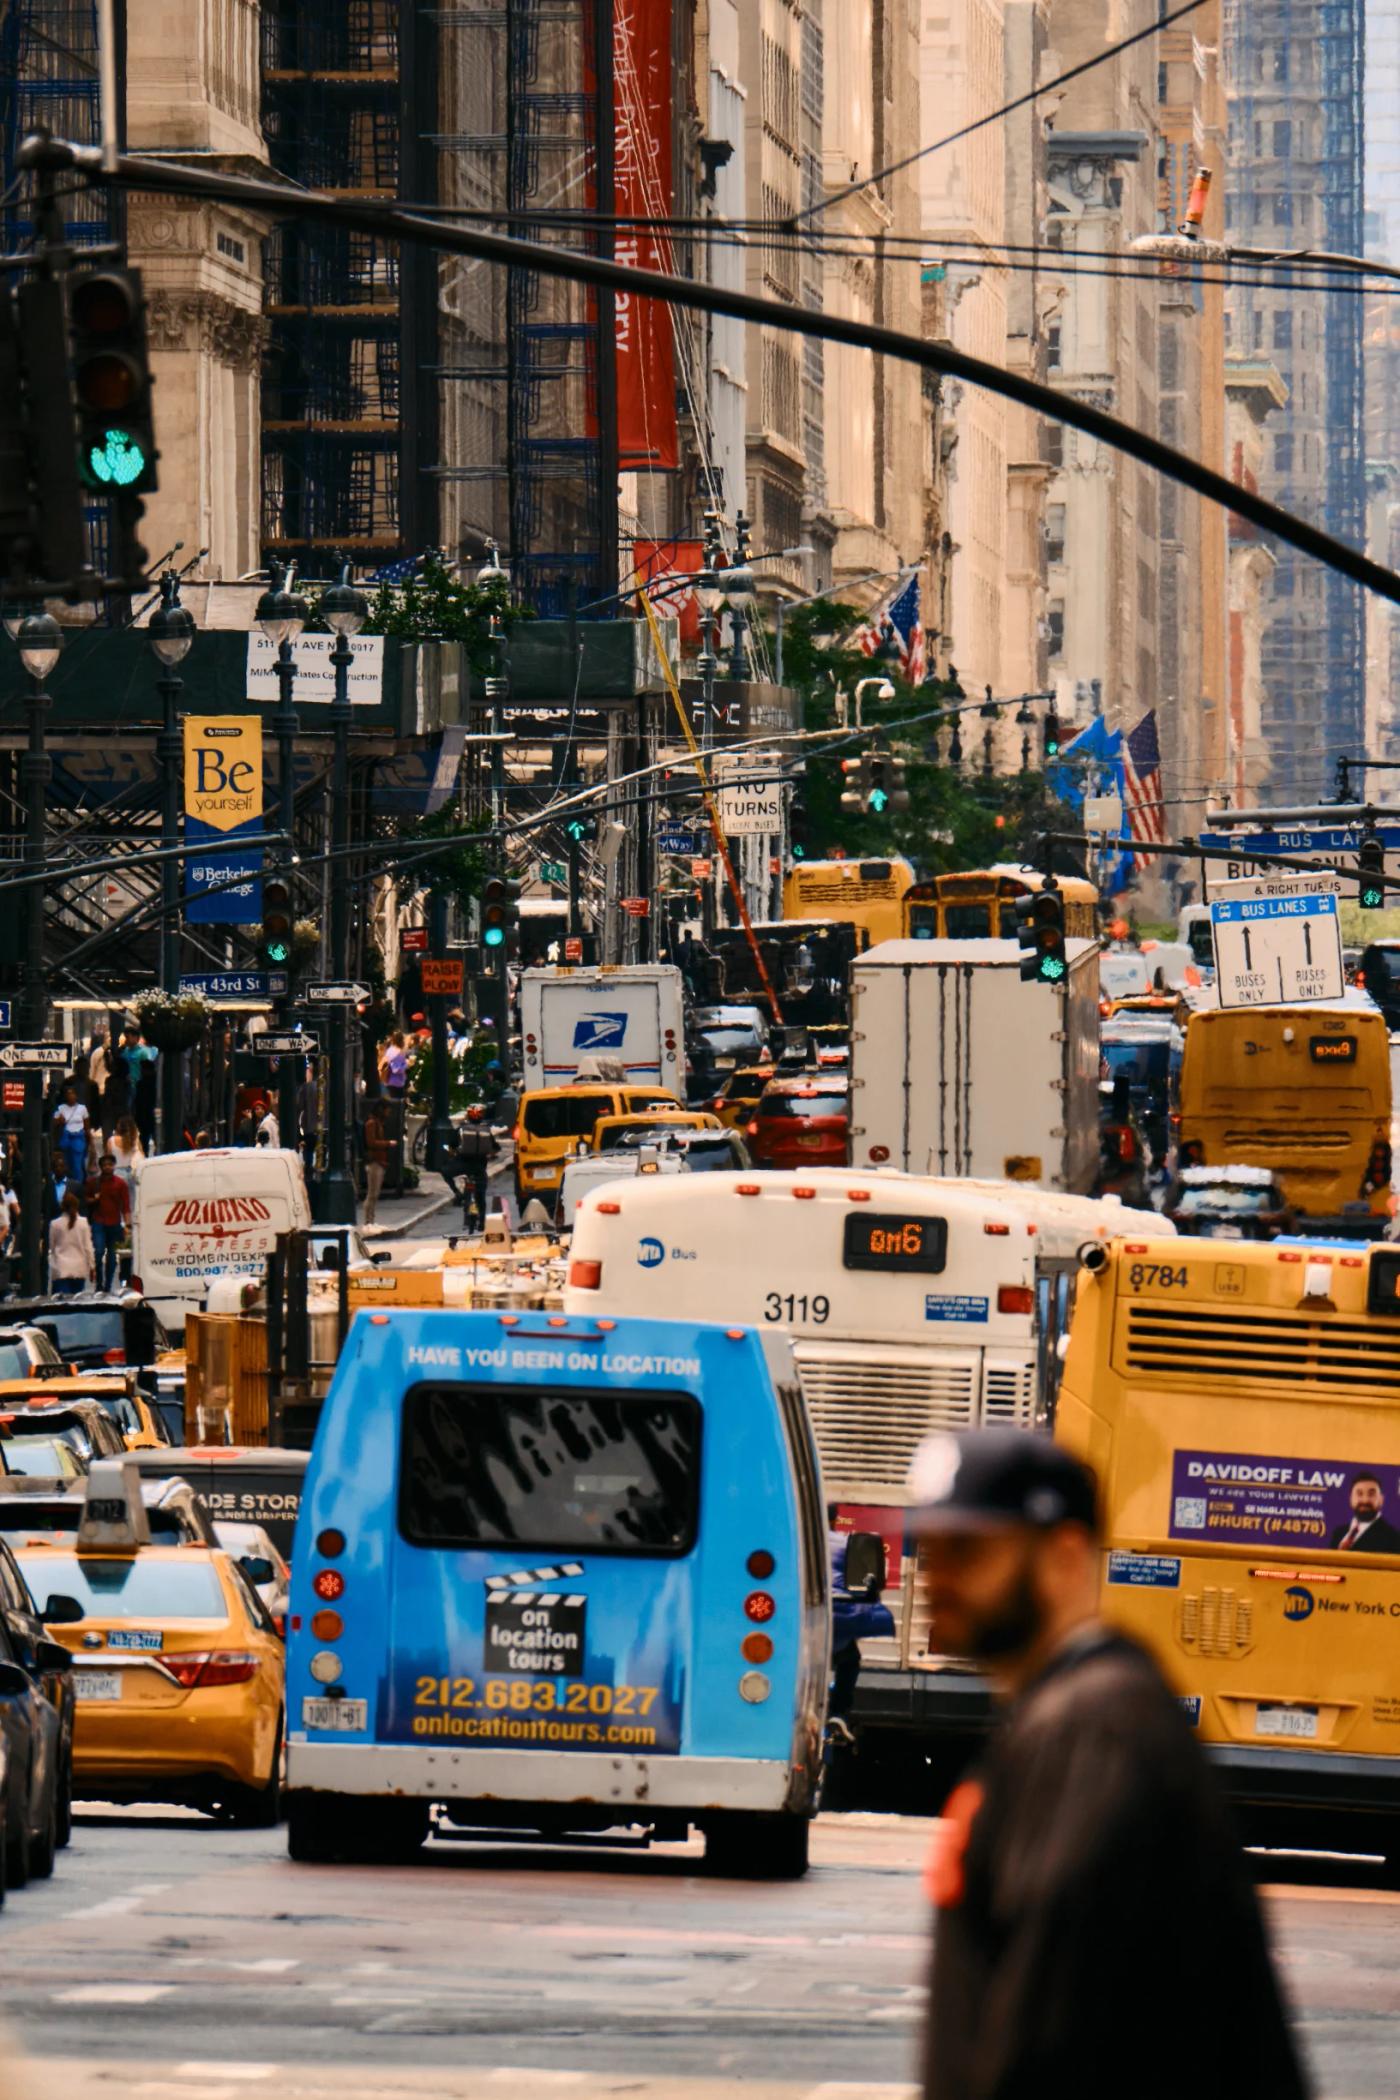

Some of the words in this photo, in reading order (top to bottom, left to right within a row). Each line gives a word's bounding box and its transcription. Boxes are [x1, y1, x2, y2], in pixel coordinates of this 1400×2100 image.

[256, 639, 274, 648] 511
[302, 642, 324, 650] AVE
[350, 644, 375, 652] 0017
[191, 748, 255, 794] Be
[195, 794, 253, 813] yourself
[725, 802, 778, 817] TURNS
[1279, 832, 1313, 848] BUS
[1254, 886, 1263, 895] &
[1267, 884, 1299, 895] RIGHT
[1241, 904, 1266, 917] BUS
[1269, 900, 1308, 915] LANES
[1235, 975, 1266, 988] BUSES
[1296, 969, 1327, 982] BUSES
[210, 978, 242, 993] 43rd
[246, 978, 260, 990] St
[312, 988, 330, 998] ONE
[343, 989, 362, 998] WAY
[1300, 984, 1325, 997] ONLY
[1239, 990, 1265, 1002] ONLY
[258, 1040, 277, 1050] ONE
[289, 1040, 308, 1050] WAY
[3, 1049, 25, 1061] ONE
[37, 1048, 61, 1060] WAY
[169, 1238, 268, 1254] EXPRESS
[671, 1248, 697, 1260] Bus
[1129, 1263, 1189, 1289] 8784
[764, 1292, 831, 1324] 3119
[408, 1345, 461, 1366] HAVE
[465, 1348, 506, 1368] YOU
[512, 1350, 563, 1370] BEEN
[567, 1351, 597, 1371] ON
[602, 1353, 701, 1376] LOCATION
[1187, 1462, 1293, 1485] DAVIDOFF
[1298, 1470, 1346, 1489] LAW
[1209, 1487, 1225, 1496] WE
[1248, 1489, 1275, 1500] YOUR
[1278, 1491, 1323, 1503] LAWYERS
[1208, 1514, 1263, 1531] #HURT
[1263, 1517, 1327, 1538] (#4878)
[1318, 1598, 1350, 1613] New
[1354, 1600, 1386, 1616] York
[521, 1609, 550, 1627] on
[490, 1623, 578, 1650] location
[508, 1647, 565, 1671] tours
[414, 1675, 659, 1716] 212.683.2027
[412, 1711, 657, 1746] onlocationtours.com
